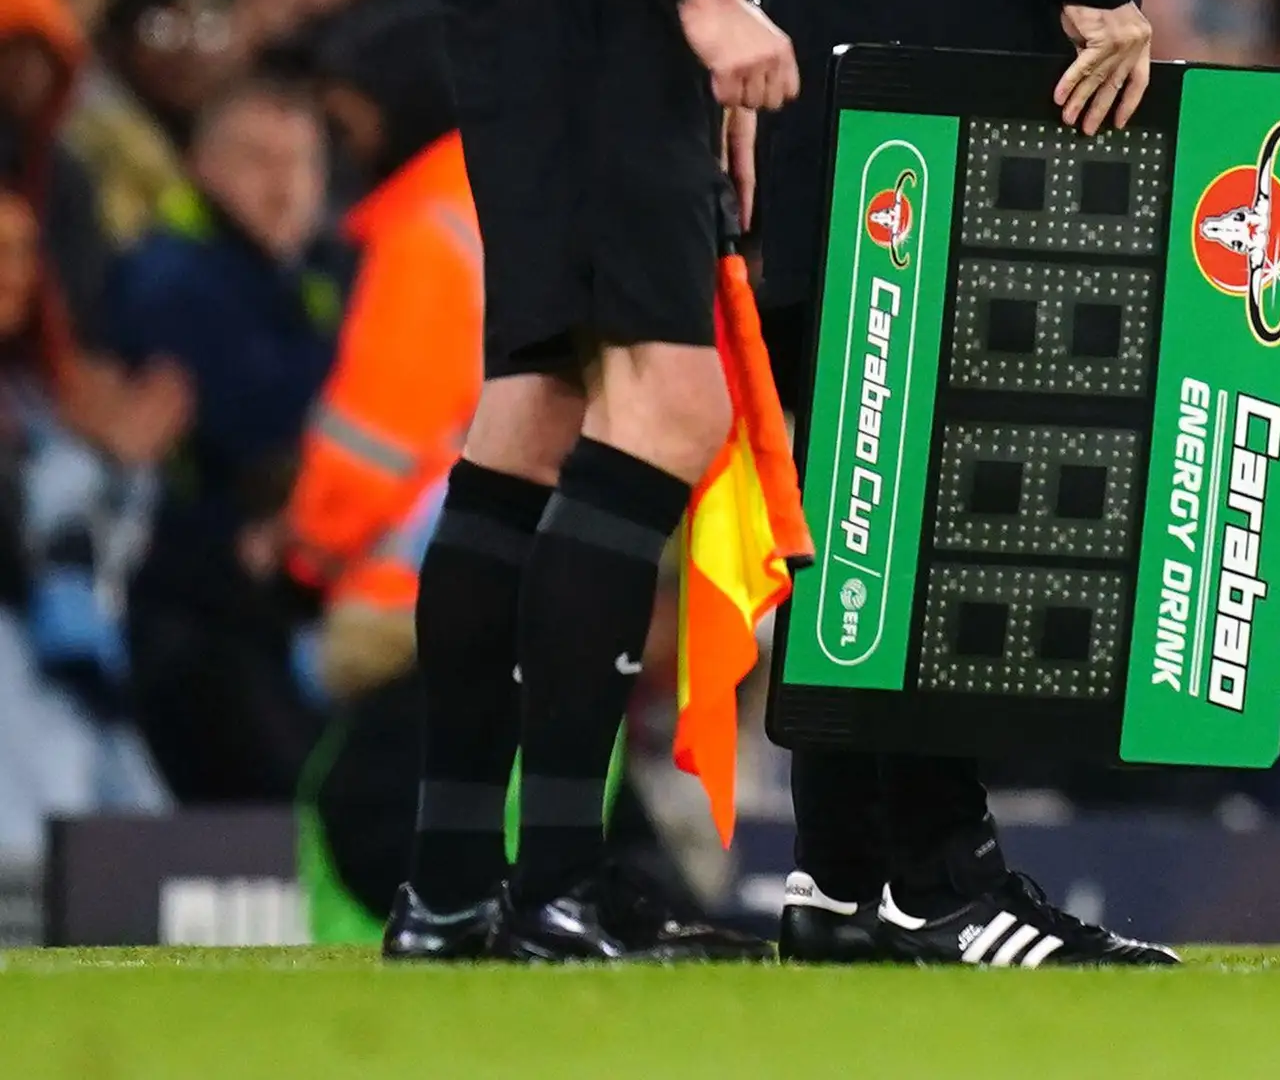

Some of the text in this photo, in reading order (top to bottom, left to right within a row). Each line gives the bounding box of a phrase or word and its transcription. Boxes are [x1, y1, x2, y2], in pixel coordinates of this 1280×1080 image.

[841, 276, 900, 554] Carabao Cup
[1151, 377, 1210, 693] ENERGY DRINK
[840, 611, 859, 648] EFL
